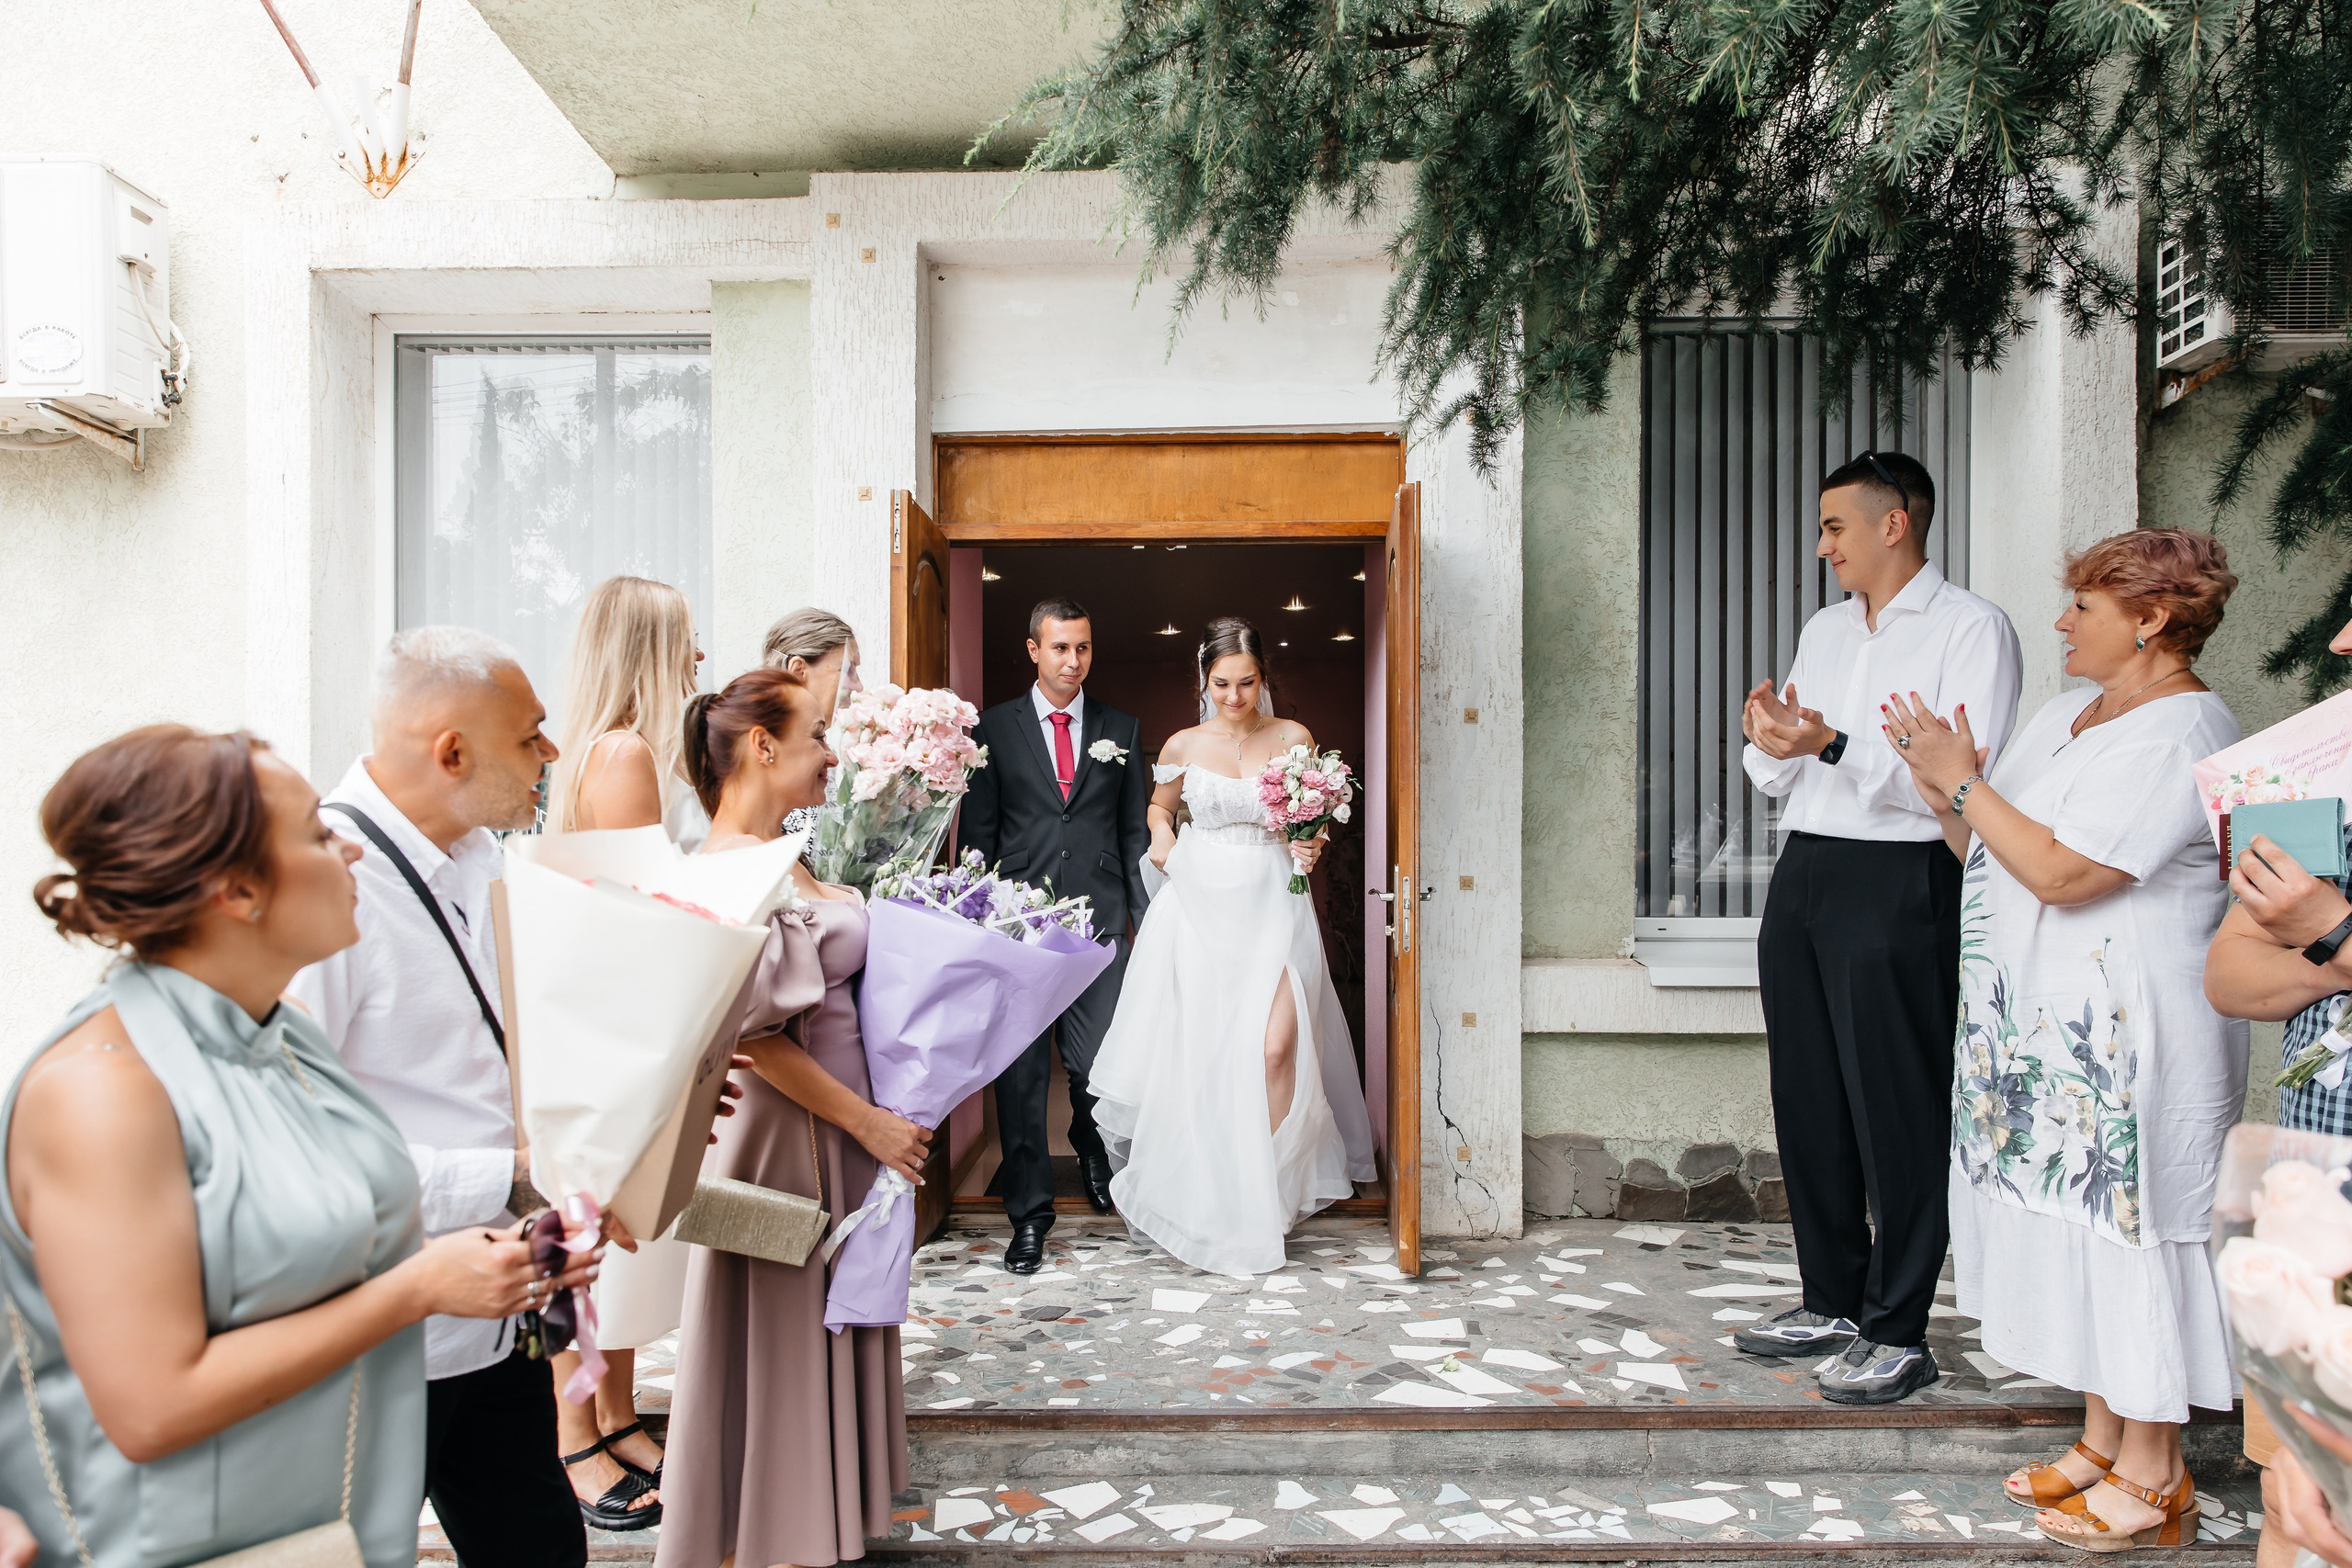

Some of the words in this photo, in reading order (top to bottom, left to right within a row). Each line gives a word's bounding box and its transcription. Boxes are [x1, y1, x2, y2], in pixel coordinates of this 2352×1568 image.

[19, 326, 41, 340] ВСЕГДА
[52, 325, 75, 339] РАБОТЕ
[18, 358, 39, 373] ВСЕГДА
[2269, 725, 2350, 769] Свидетельство
[2292, 740, 2352, 778] заключении
[2307, 759, 2338, 780] брака
